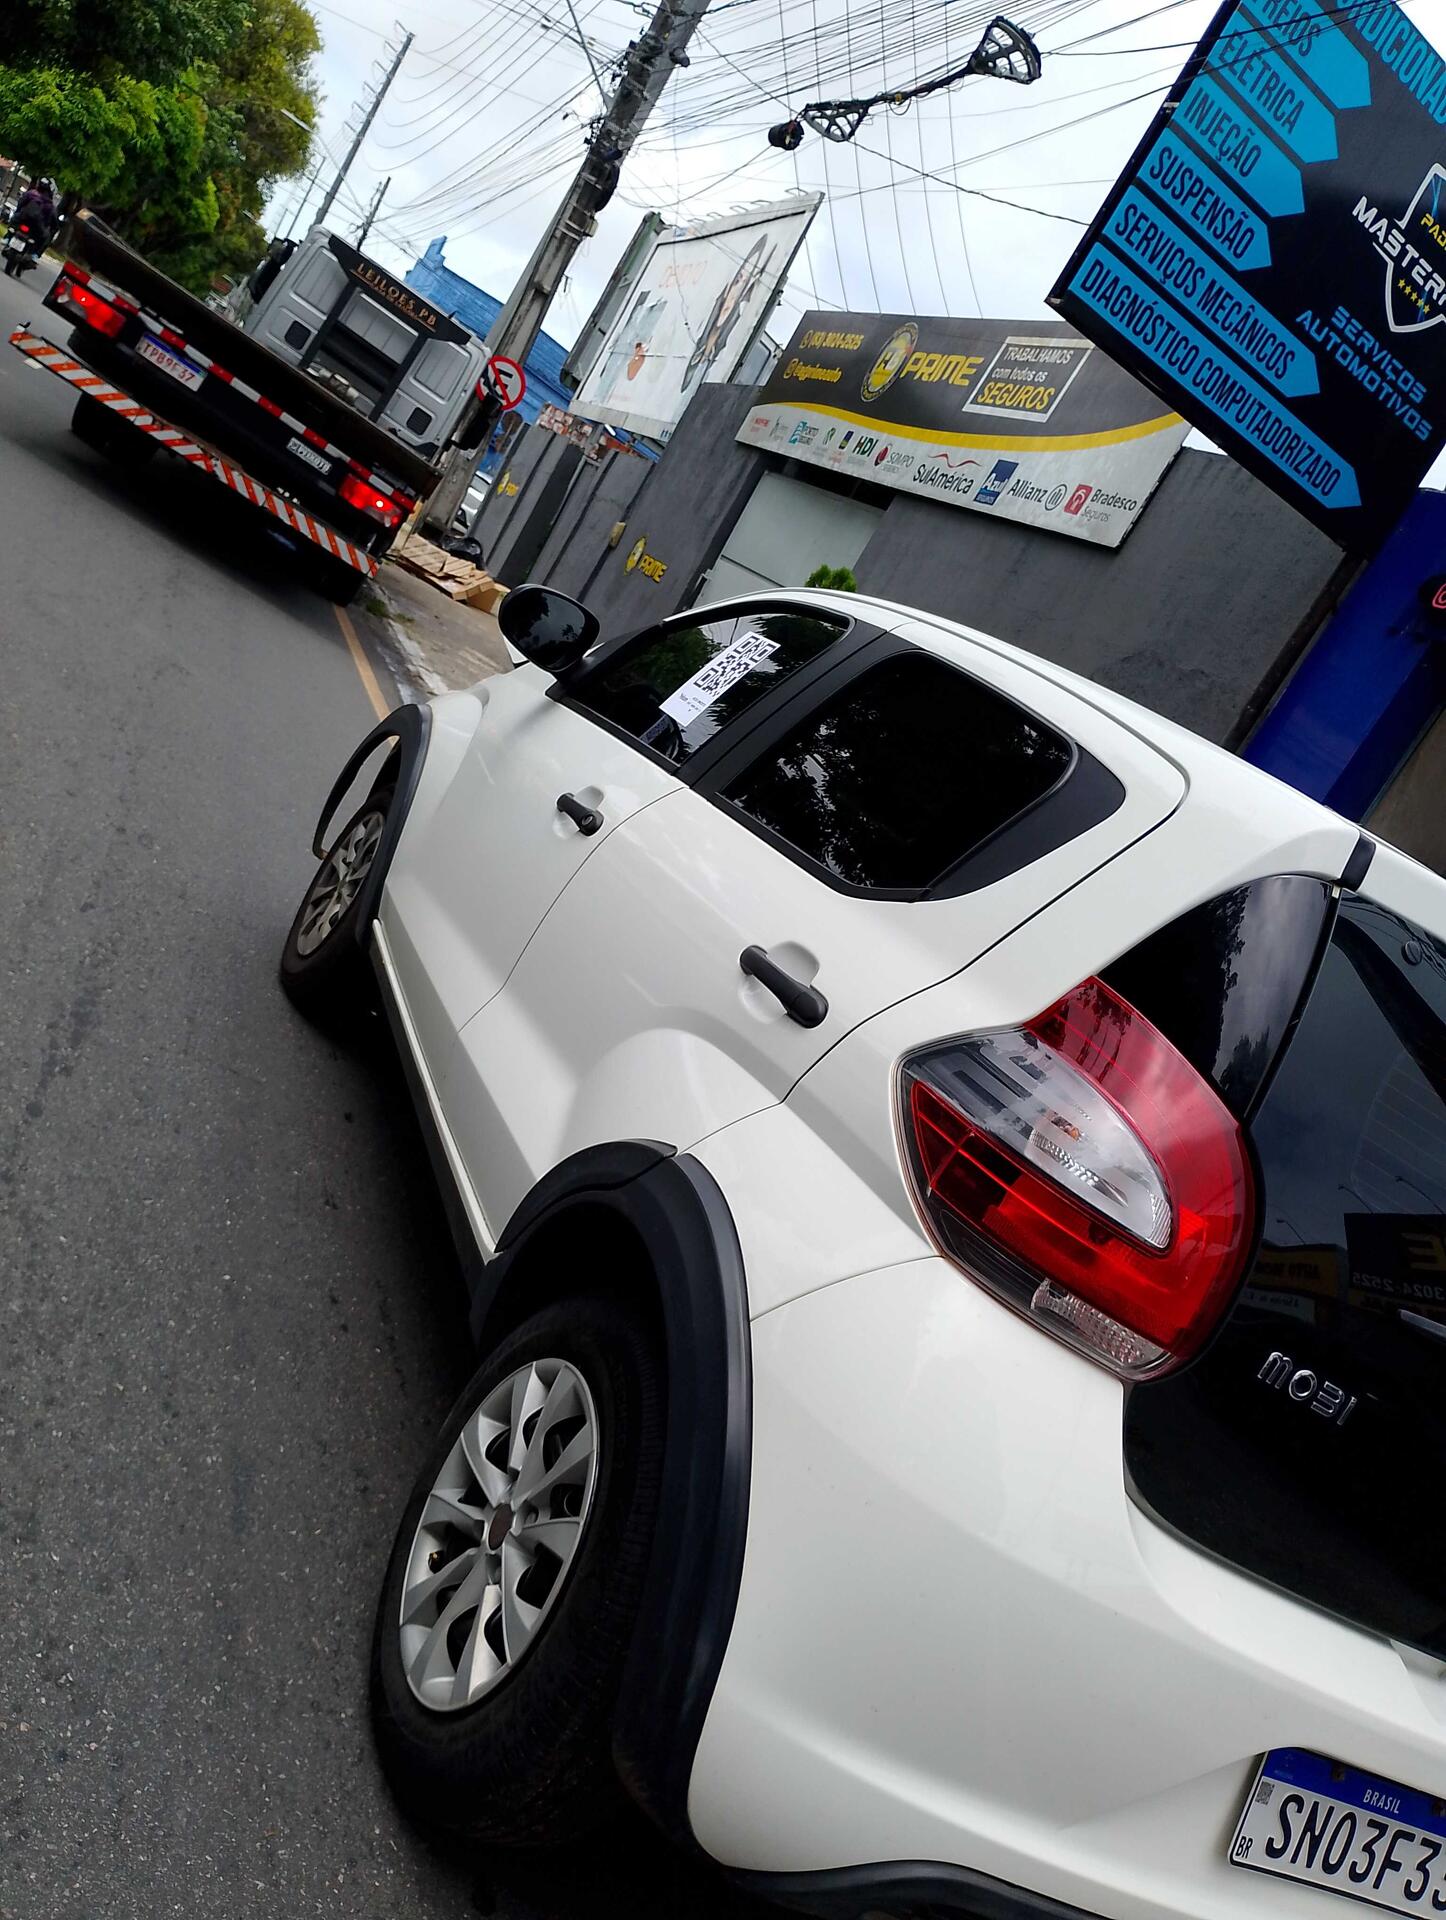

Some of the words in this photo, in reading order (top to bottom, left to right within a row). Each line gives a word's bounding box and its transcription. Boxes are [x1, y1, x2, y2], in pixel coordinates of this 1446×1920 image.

[1253, 0, 1320, 57] REIOS
[1220, 29, 1305, 135] ELÉTRICA
[1183, 87, 1262, 177] INJEÇÃO
[1149, 146, 1256, 260] SUSPENSÃO
[1352, 195, 1446, 308] MASTER
[1114, 203, 1206, 298] SERVIÇOS
[1200, 280, 1296, 380] MECÂNICOS
[900, 351, 985, 387] PRIME
[1003, 346, 1074, 364] TRABALHAMOS
[1331, 305, 1428, 404] SERVIÇOS
[991, 366, 1012, 380] com
[1009, 366, 1037, 382] todos
[1034, 370, 1049, 383] os
[1079, 258, 1200, 373] DIAGNÓSTICO
[1191, 358, 1342, 498] COMPUTADORIZADO
[1295, 309, 1433, 441] AUTOMOTIVOS
[976, 381, 1056, 411] SEGUROS
[852, 435, 880, 459] HDI
[912, 463, 975, 496] SulAmérica
[1006, 478, 1048, 504] Allianz
[1090, 488, 1138, 513] Bradesco
[1362, 1789, 1402, 1815] BRASIL
[1235, 1835, 1254, 1860] BR
